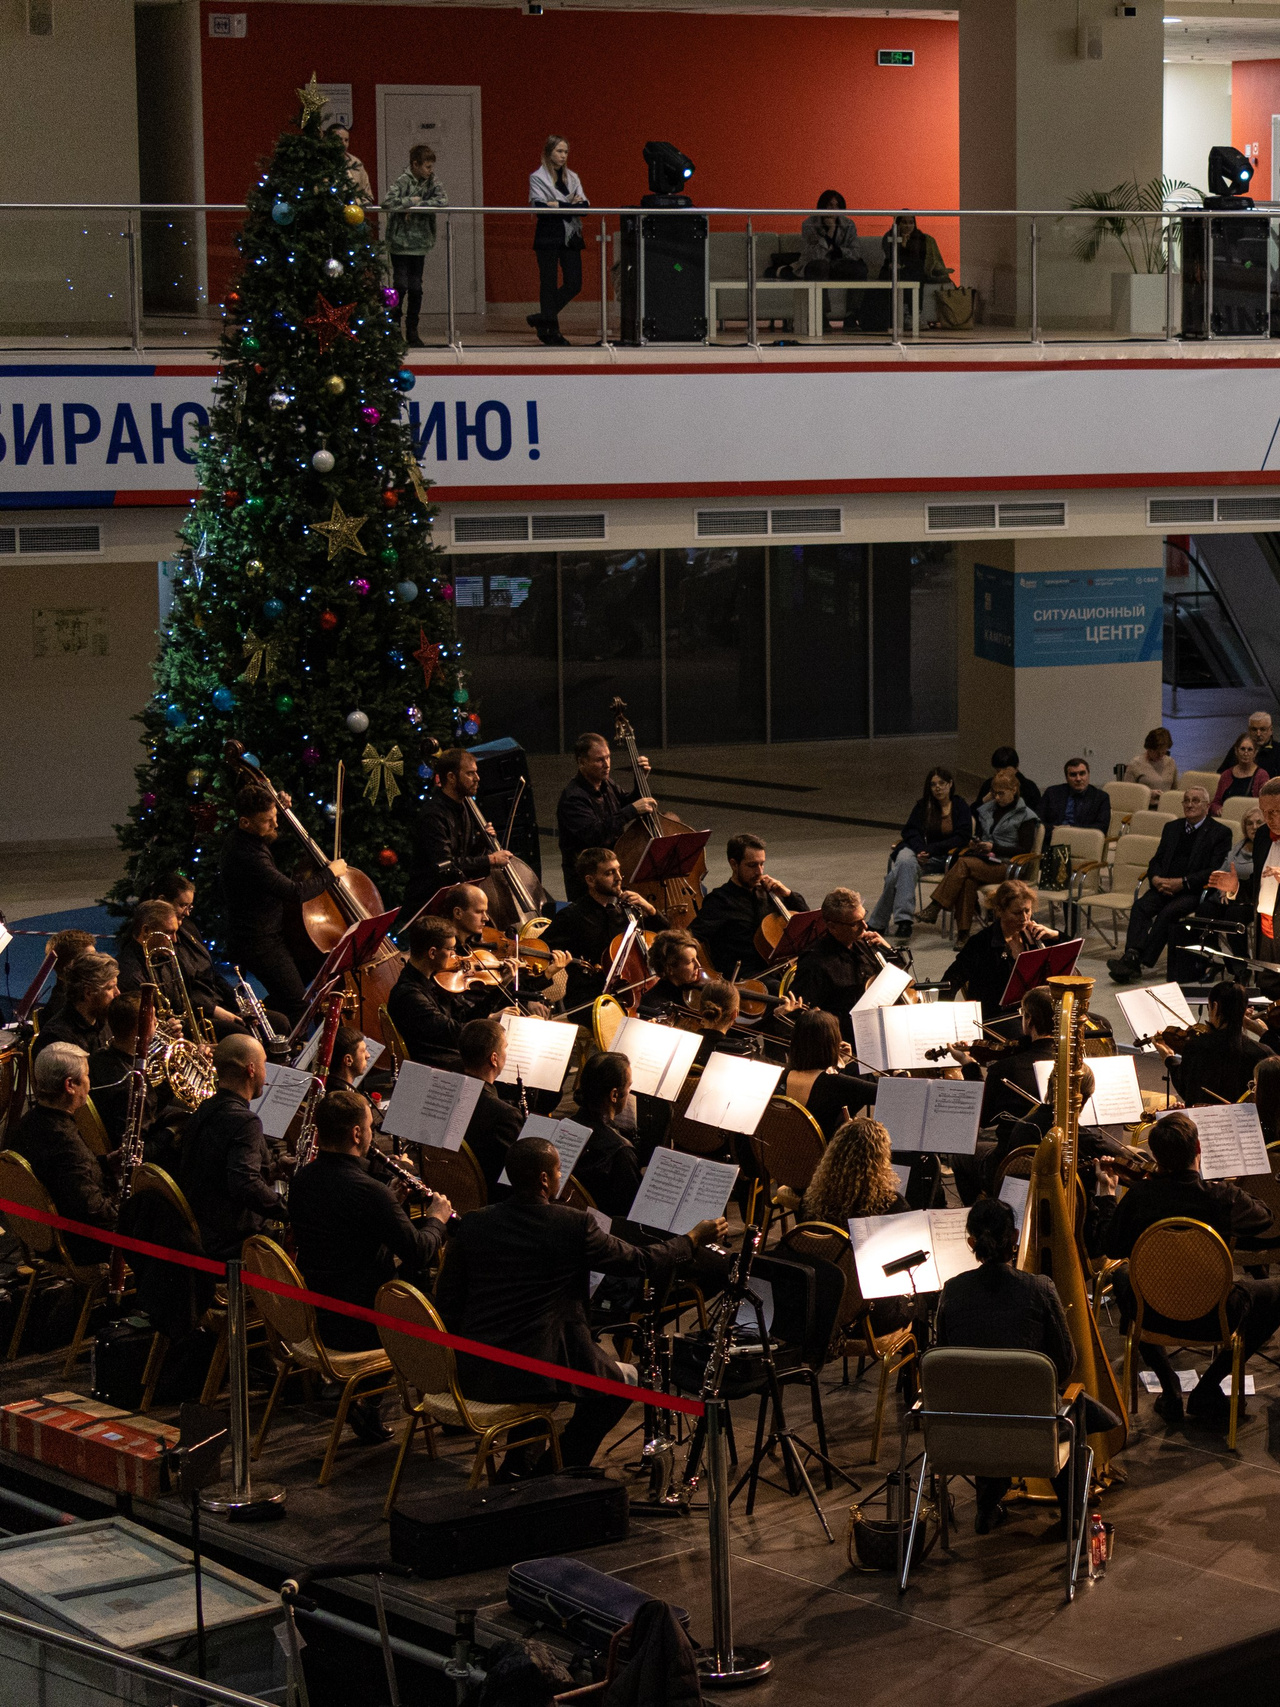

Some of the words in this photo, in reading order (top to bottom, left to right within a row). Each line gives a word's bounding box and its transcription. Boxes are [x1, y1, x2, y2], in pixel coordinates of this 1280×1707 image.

[0, 402, 210, 465] ИРАЮ
[1034, 604, 1145, 621] СИТУАЦИОННЫЙ
[1086, 624, 1146, 644] ЦЕНТР
